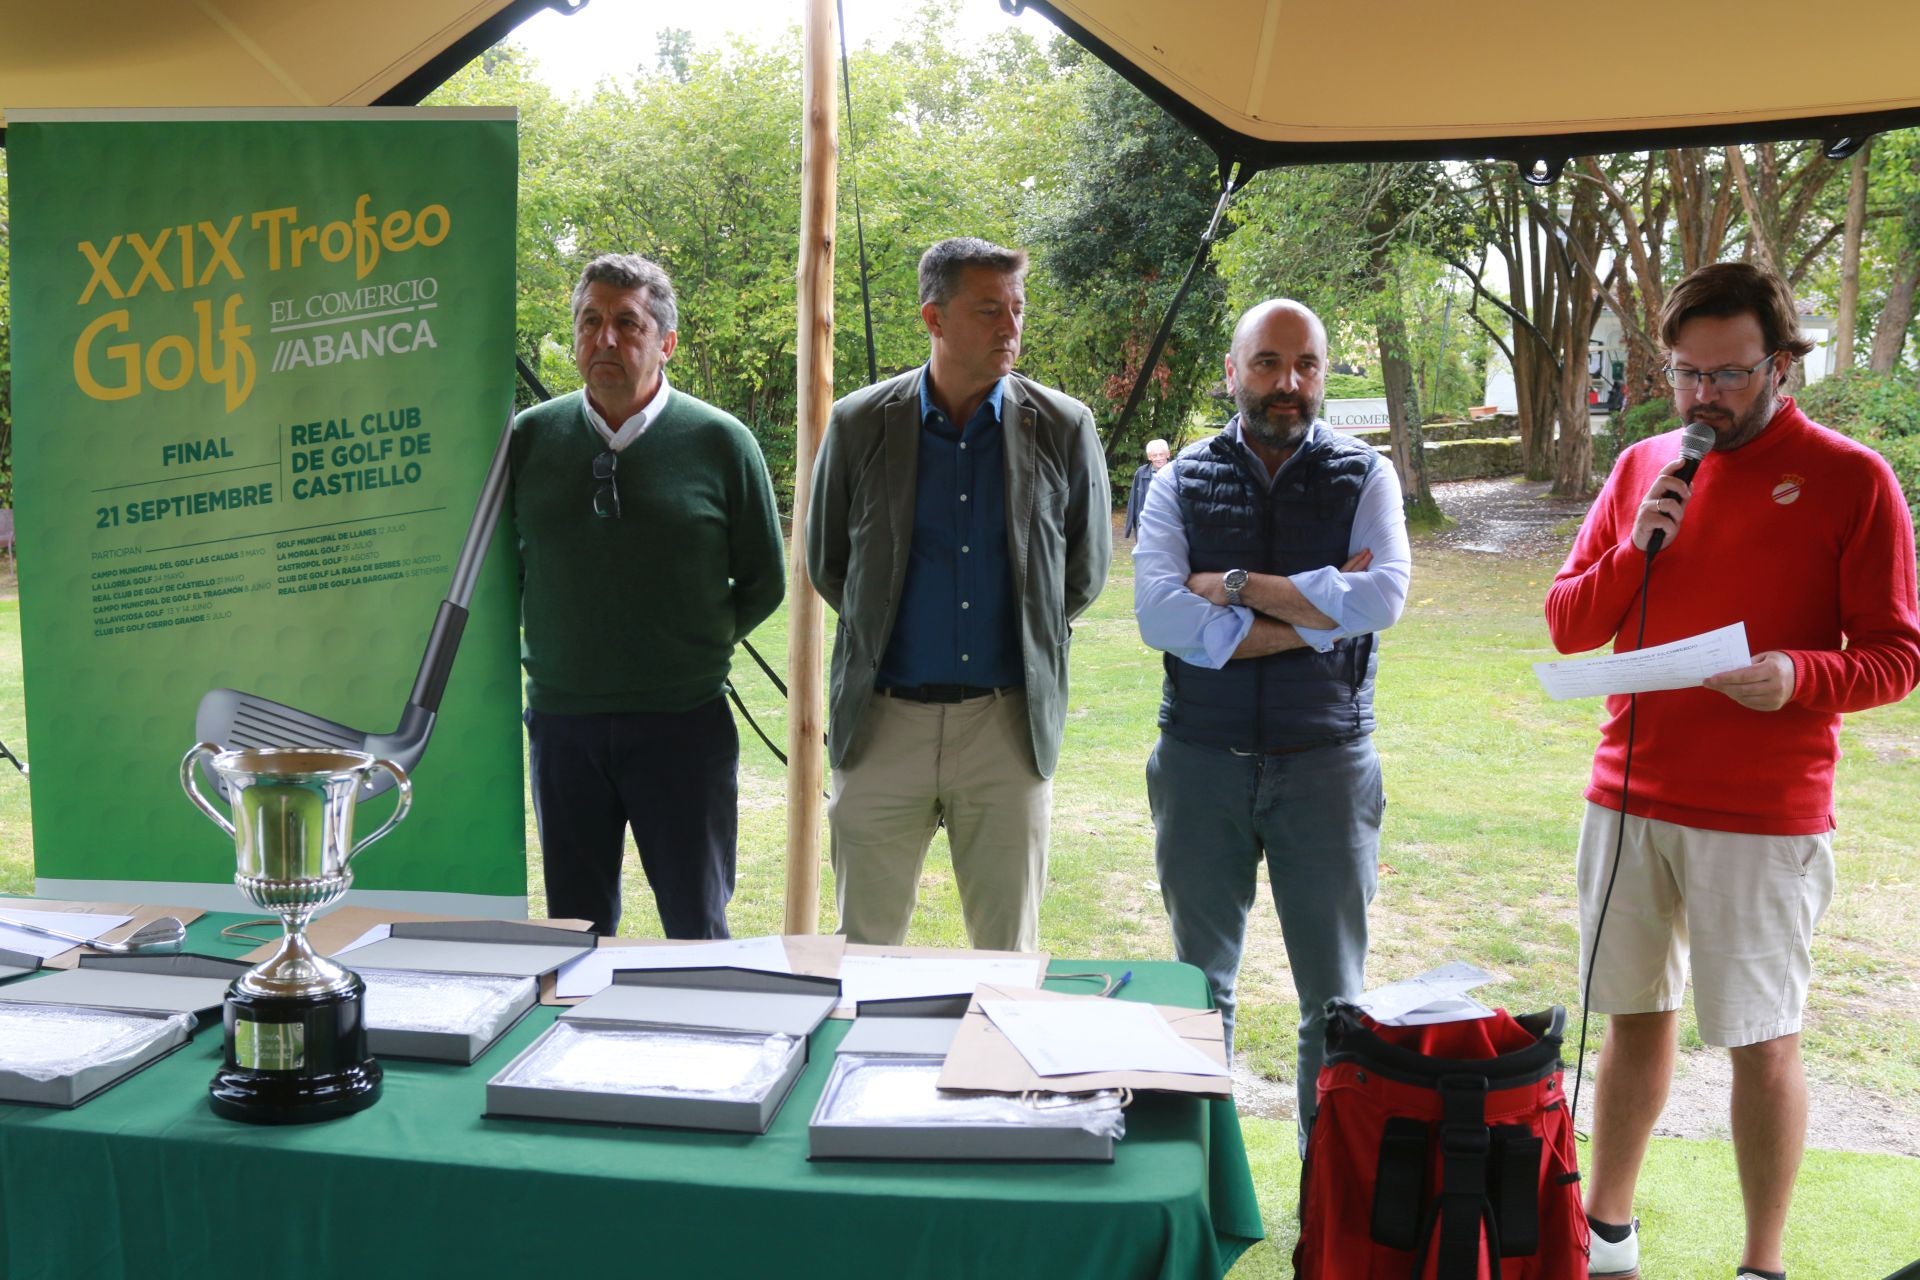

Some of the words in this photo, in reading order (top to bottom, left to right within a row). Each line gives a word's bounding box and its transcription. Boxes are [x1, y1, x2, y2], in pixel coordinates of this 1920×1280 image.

[77, 215, 245, 305] XXIX
[251, 193, 451, 280] Trofeo
[270, 299, 301, 323] EL
[305, 277, 438, 318] COMERCIO
[72, 293, 256, 414] Golf
[291, 418, 355, 446] REAL
[360, 407, 421, 436] CLUB
[1330, 415, 1343, 425] EL
[162, 438, 233, 466] FINAL
[292, 449, 325, 473] DE
[332, 441, 392, 468] GOLF
[400, 433, 431, 456] DE
[292, 462, 421, 501] CASTIELLO
[96, 506, 119, 529] 21
[126, 483, 272, 524] SEPTIEMBRE
[277, 540, 296, 549] GOLF
[297, 534, 336, 546] MUNICIPAL
[349, 528, 377, 538] LLANES
[92, 546, 142, 560] PARTICIPAN
[288, 548, 319, 558] MORGAL
[320, 545, 341, 554] GOLF
[92, 569, 118, 580] CAMPO
[119, 563, 157, 576] MUNICIPAL
[159, 561, 173, 570] DEL
[175, 558, 194, 567] GOLF
[196, 556, 209, 564] LAS
[211, 552, 238, 562] CALDAS
[278, 561, 320, 572] CASTROPOL
[322, 557, 342, 566] GOLF
[278, 575, 296, 584] CLUB
[298, 572, 308, 581] DE
[309, 570, 329, 579] GOLF
[342, 564, 362, 574] RASA
[92, 583, 102, 591] LA
[104, 580, 132, 589] LLOREA
[133, 576, 152, 585] GOLF
[93, 594, 112, 602] REAL
[113, 590, 132, 600] CLUB
[134, 588, 143, 596] DE
[145, 585, 164, 594] GOLF
[177, 578, 215, 590] CASTIELLO
[278, 586, 297, 595] REAL
[298, 583, 318, 593] CLUB
[319, 581, 329, 590] DE
[330, 578, 350, 588] GOLF
[93, 604, 119, 614] CAMPO
[121, 598, 159, 610] MUNICIPAL
[161, 596, 171, 604] DE
[172, 593, 192, 602] GOLF
[94, 613, 143, 625] VILLAVICIOSA
[145, 609, 164, 618] GOLF
[94, 628, 114, 636] CLUB
[115, 625, 125, 633] DE
[126, 622, 146, 632] GOLF
[147, 619, 173, 629] CIERRO
[175, 614, 205, 625] GRANDE
